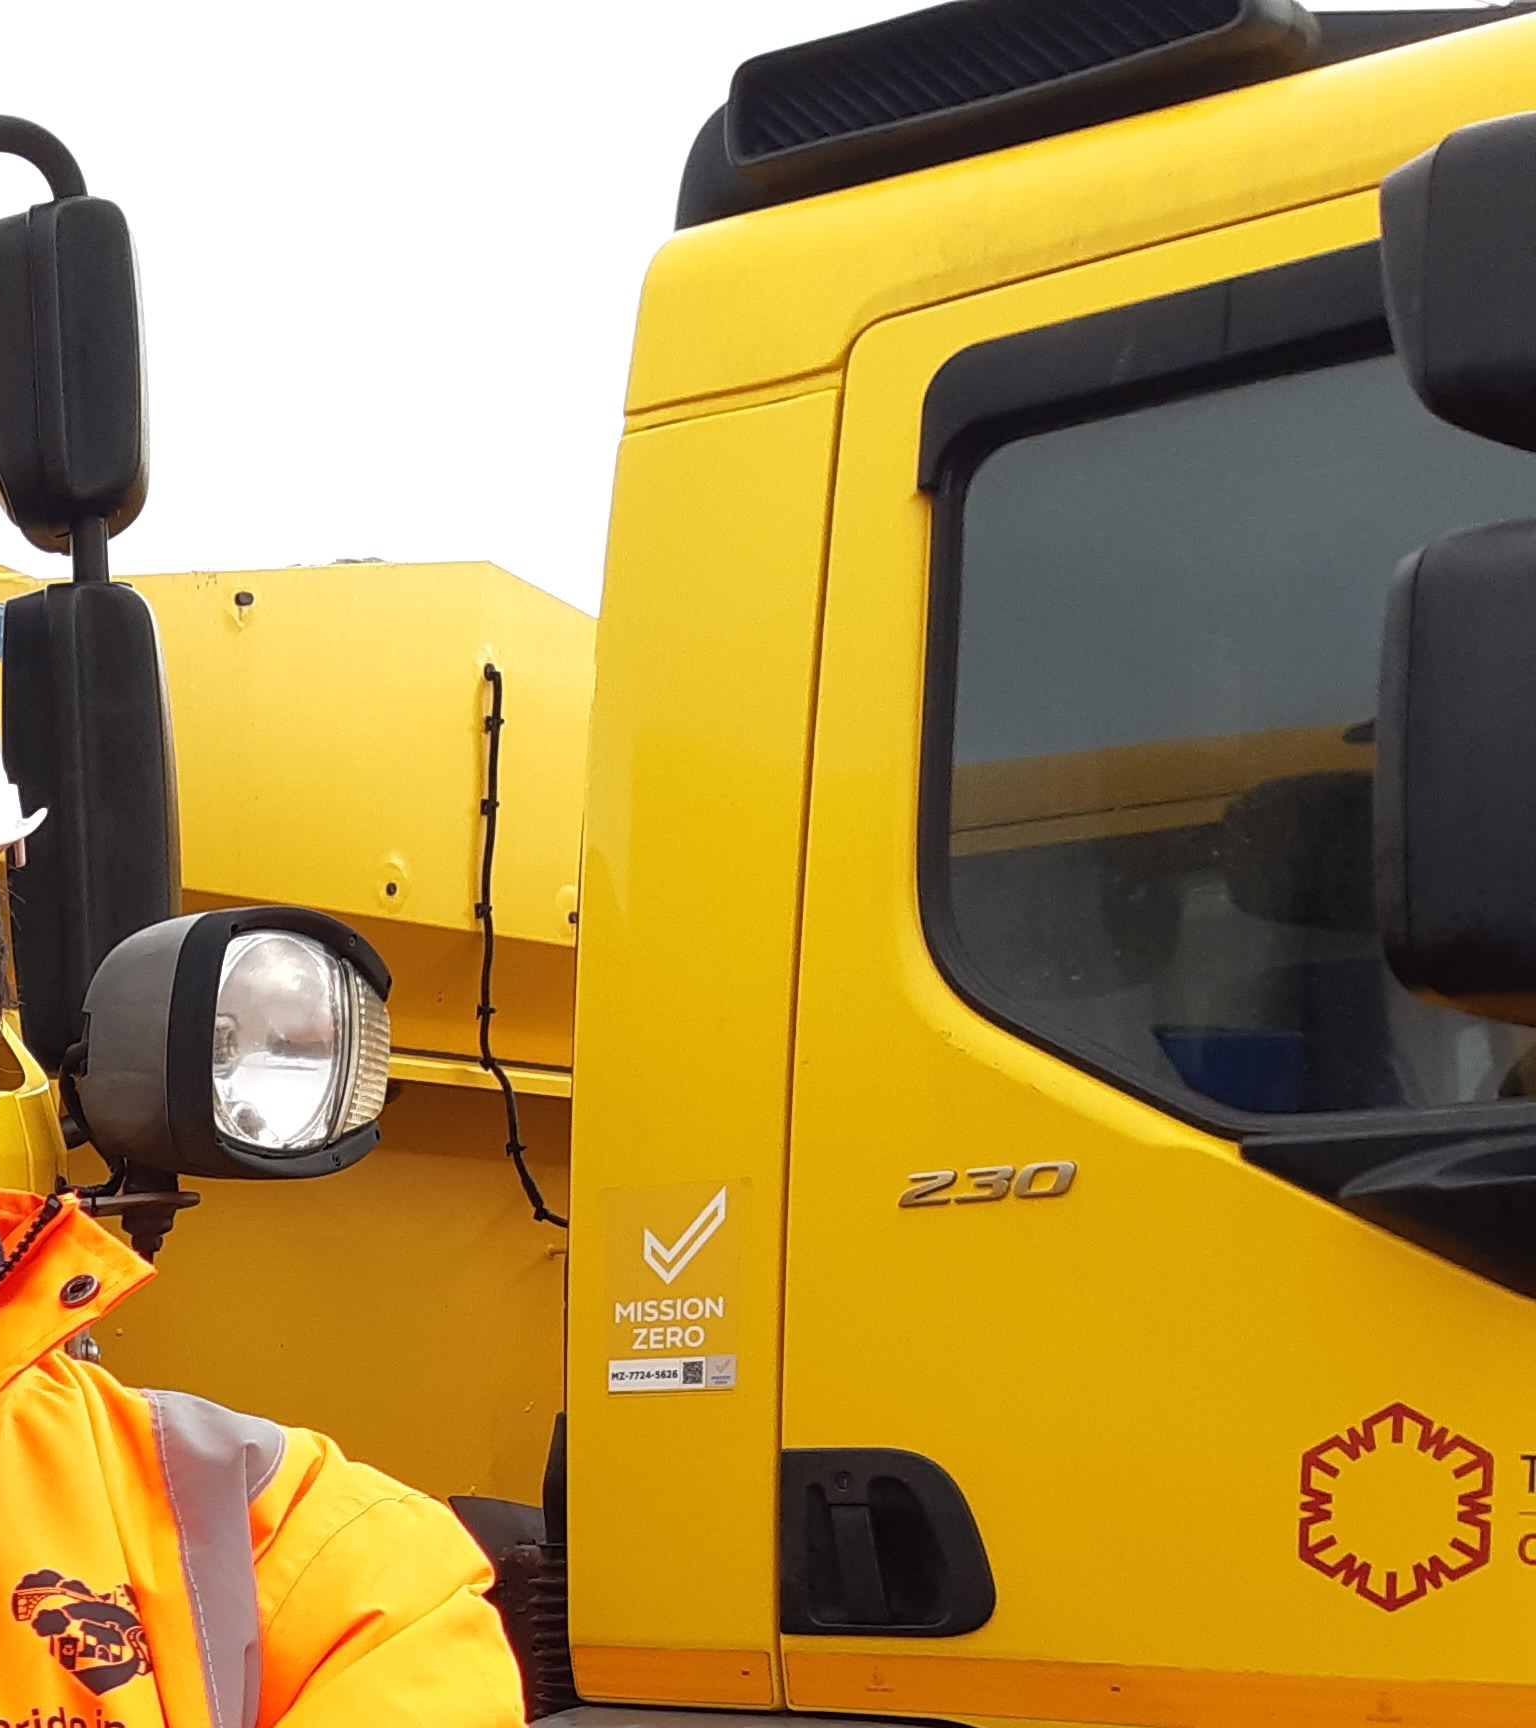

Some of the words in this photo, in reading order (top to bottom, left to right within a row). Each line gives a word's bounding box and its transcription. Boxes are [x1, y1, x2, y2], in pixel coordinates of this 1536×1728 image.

[898, 1160, 1078, 1208] 230
[614, 1296, 724, 1324] MISSION
[632, 1325, 705, 1350] ZERO
